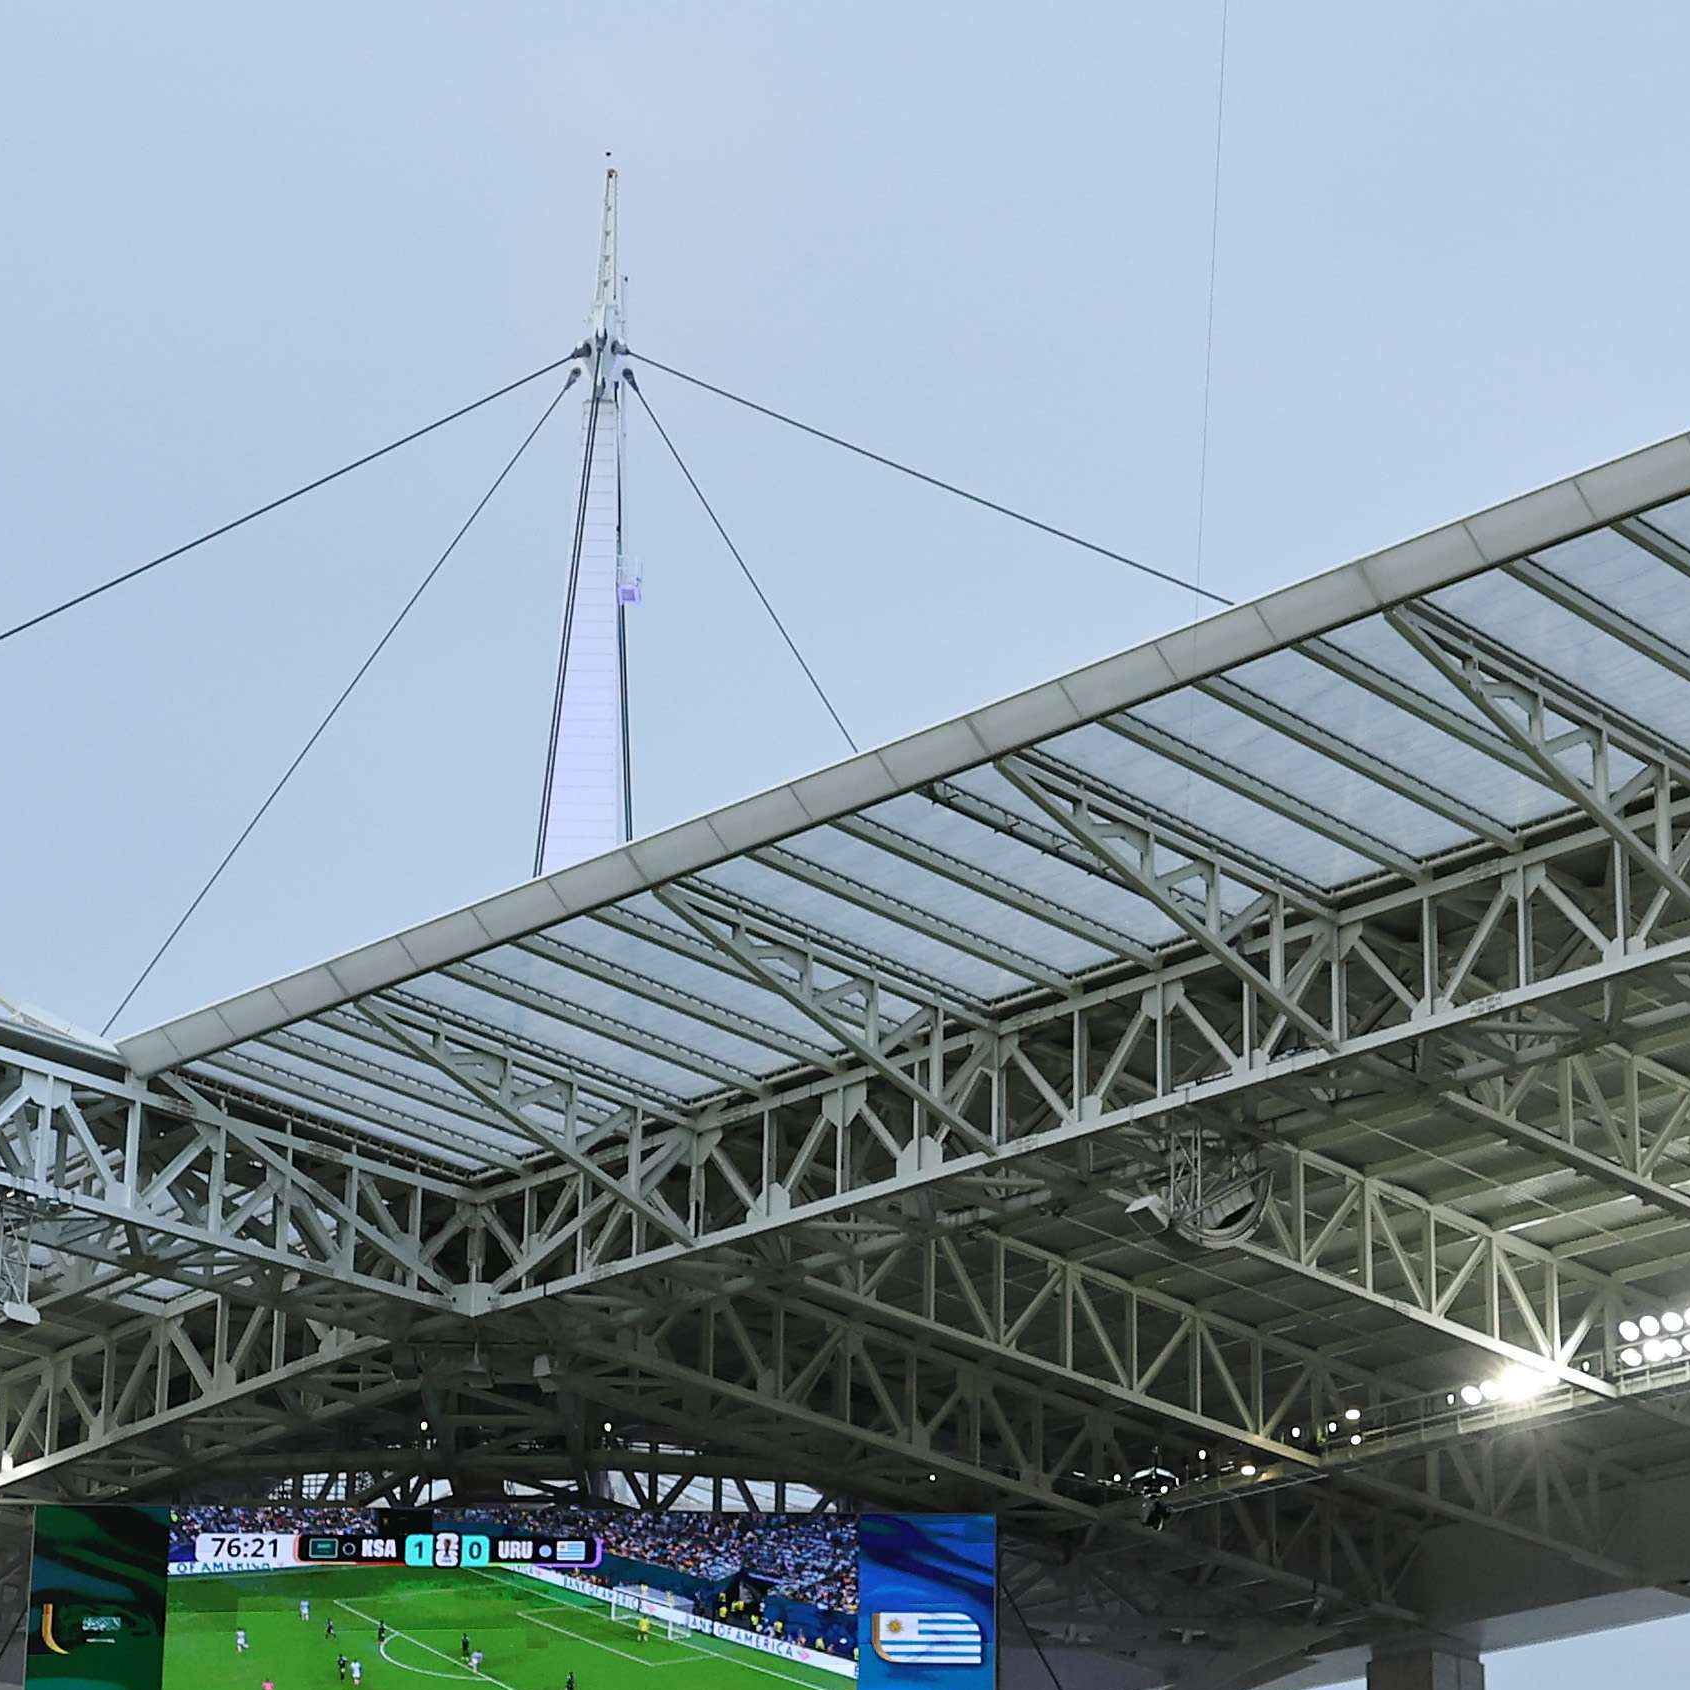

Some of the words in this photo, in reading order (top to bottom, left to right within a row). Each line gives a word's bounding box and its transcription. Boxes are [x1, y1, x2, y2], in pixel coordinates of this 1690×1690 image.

[211, 1537, 279, 1558] 76:21
[361, 1539, 397, 1558] KSA
[413, 1540, 424, 1559] 1
[468, 1540, 481, 1559] 0
[498, 1540, 533, 1559] URU
